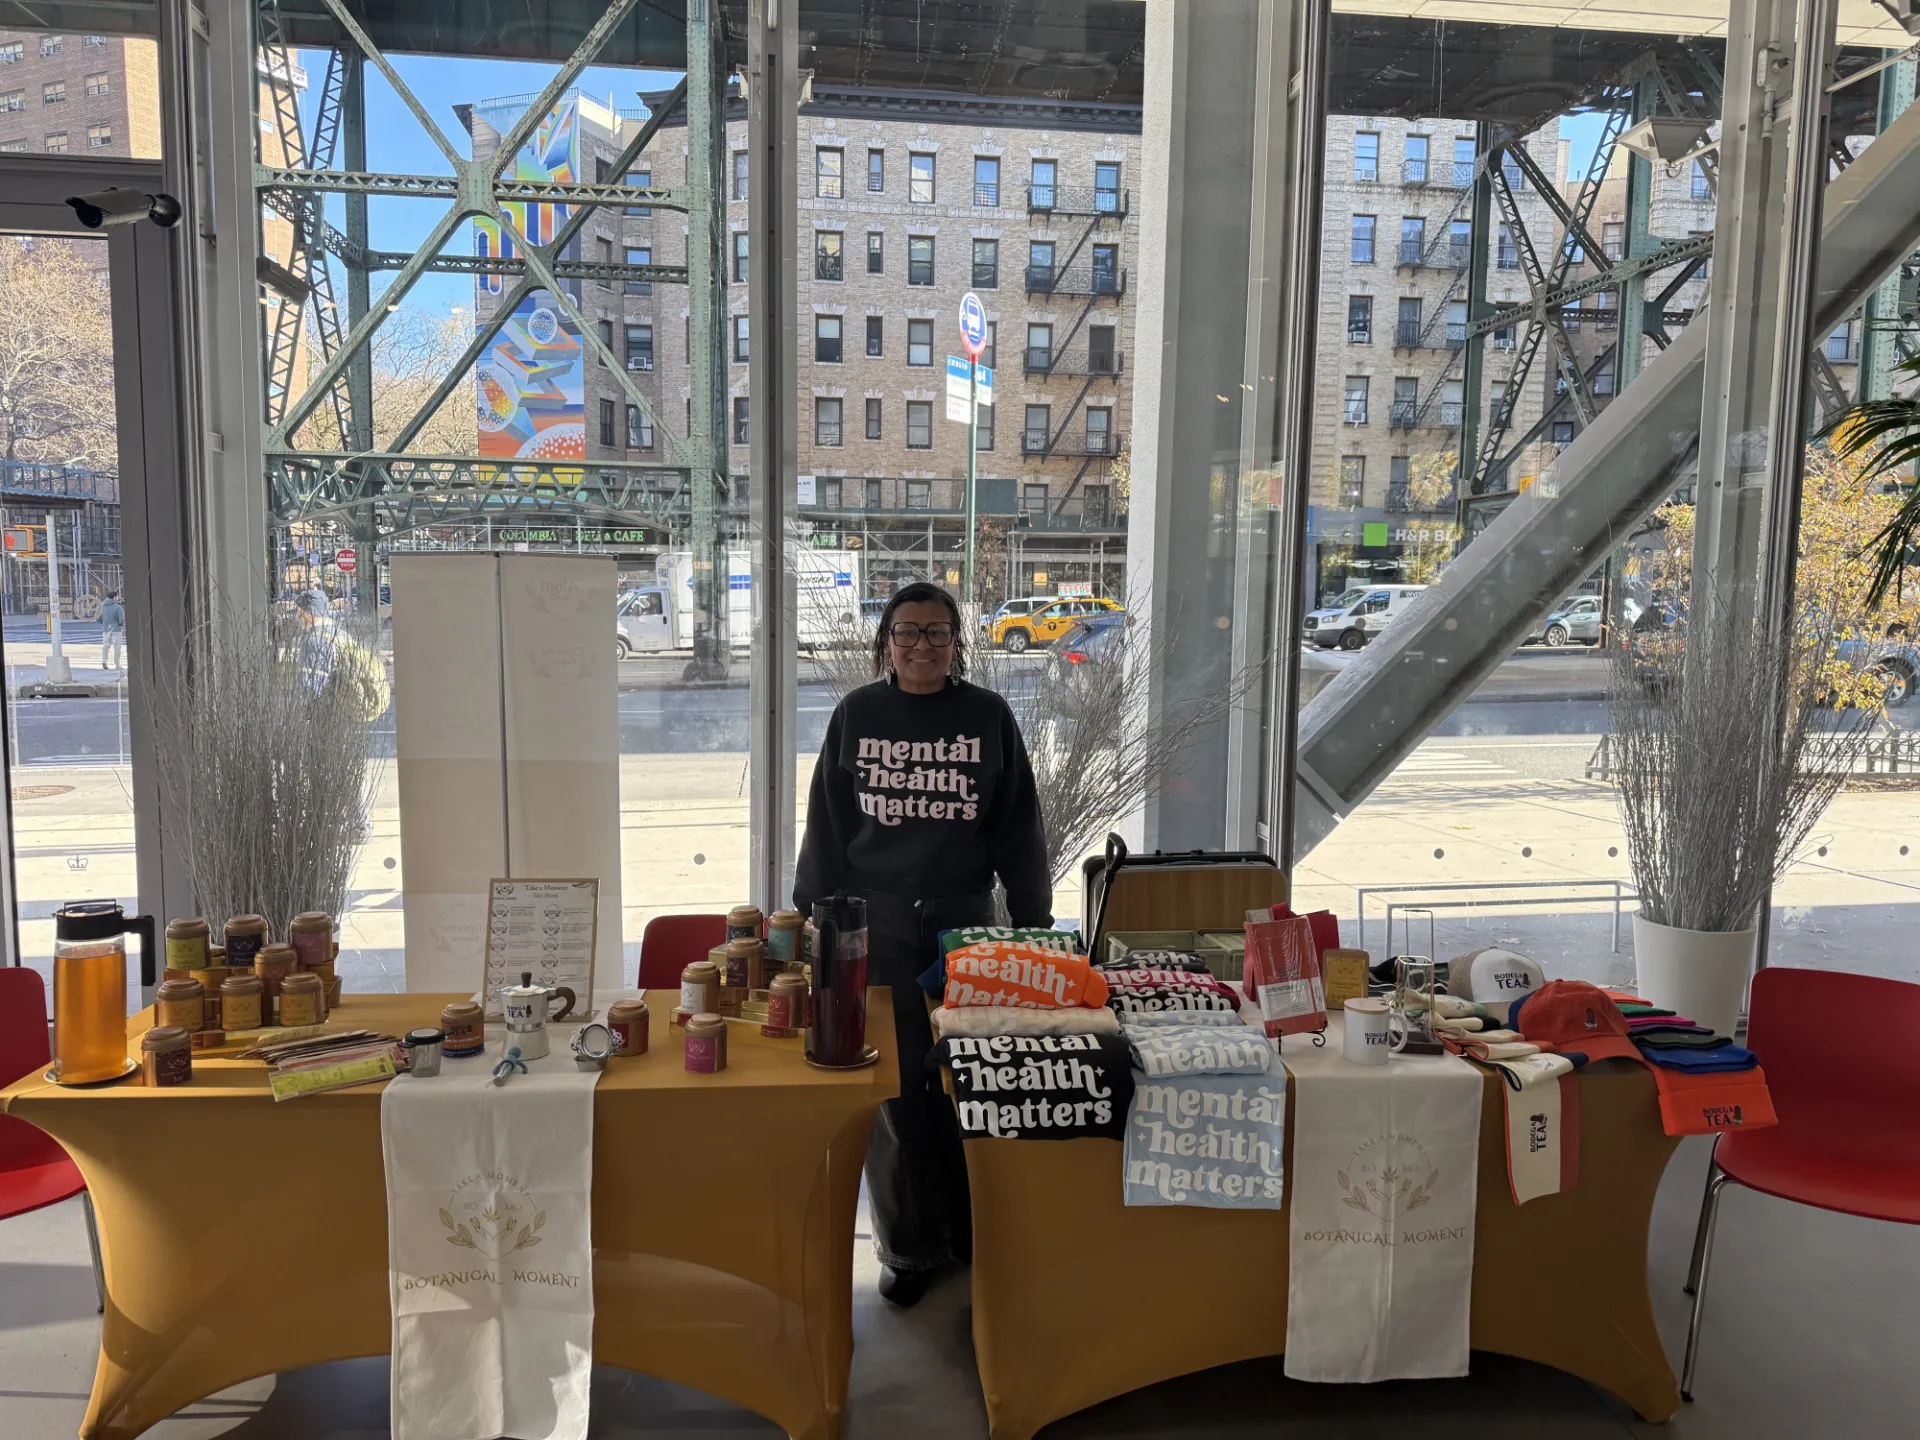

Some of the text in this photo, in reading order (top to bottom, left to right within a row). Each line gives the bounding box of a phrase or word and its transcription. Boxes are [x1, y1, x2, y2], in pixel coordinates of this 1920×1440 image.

[499, 530, 558, 541] COLUMBIA
[575, 530, 602, 541] DELI
[613, 531, 644, 542] CAFE
[811, 534, 837, 546] AFE
[1395, 529, 1429, 541] H&R
[857, 734, 981, 769] mental
[856, 760, 979, 801] health
[858, 792, 978, 826] matters
[948, 979, 1056, 1009] matt
[950, 953, 1076, 1006] health
[1495, 979, 1522, 990] TEA
[508, 1010, 524, 1019] TEA
[947, 1033, 1103, 1064] mental
[1136, 1039, 1271, 1075] health
[952, 1056, 1112, 1099] health
[958, 1098, 1112, 1138] matters
[1135, 1084, 1286, 1130] mental
[1703, 1106, 1733, 1116] BODEGA
[1704, 1114, 1732, 1127] TEA
[1134, 1114, 1284, 1177] health
[1352, 1137, 1376, 1156] TAKE
[1389, 1132, 1428, 1156] MOMENT
[1537, 1124, 1547, 1153] TEA
[451, 1175, 474, 1195] TAKE
[487, 1171, 531, 1197] MOMENT
[1128, 1159, 1284, 1202] matters
[504, 1202, 522, 1211] MO
[1303, 1227, 1466, 1246] BOTANICAL MOMENT
[403, 1269, 580, 1290] BOTANICAL MOMENT
